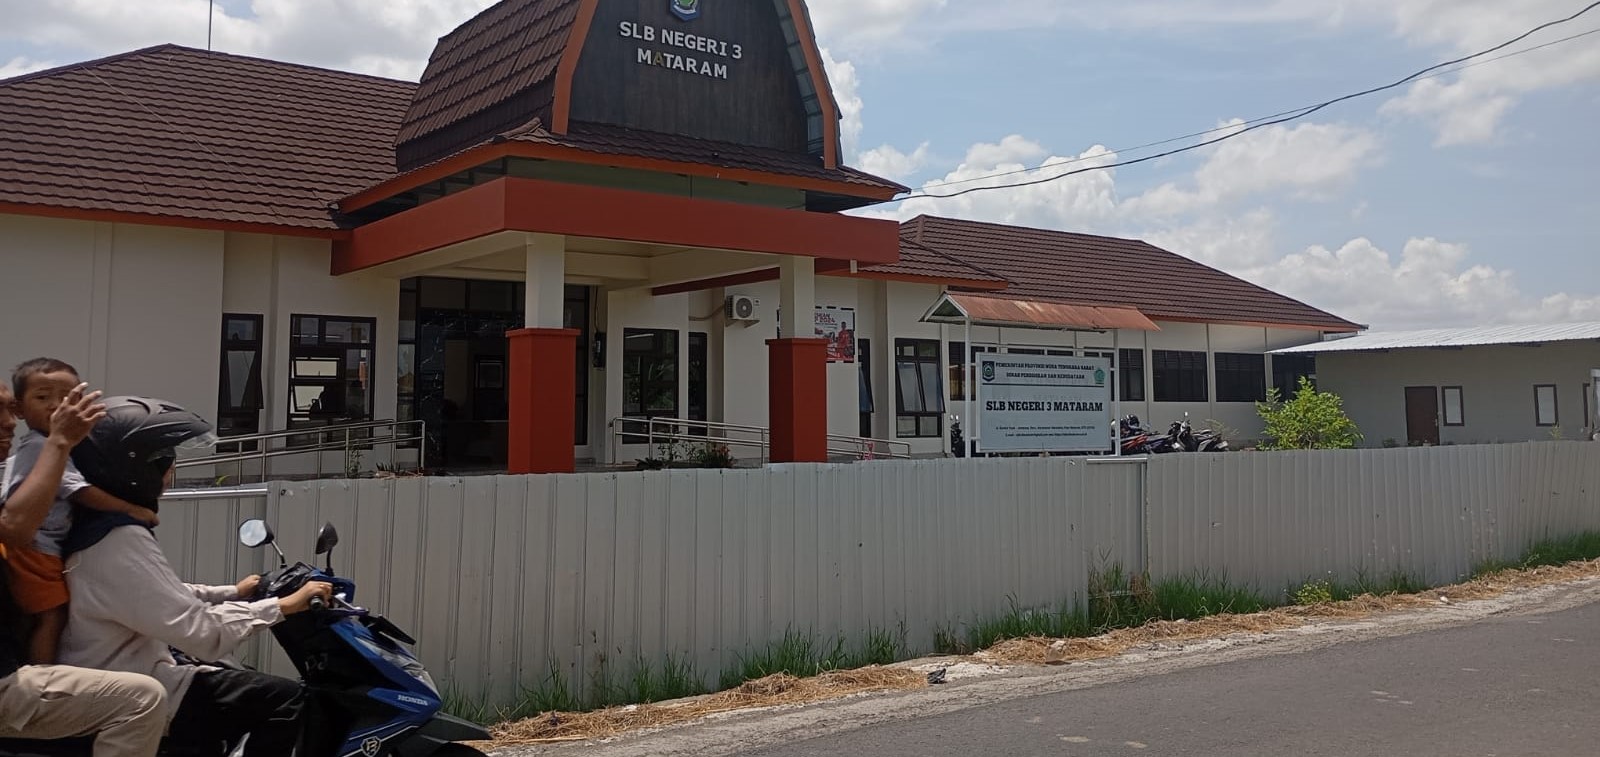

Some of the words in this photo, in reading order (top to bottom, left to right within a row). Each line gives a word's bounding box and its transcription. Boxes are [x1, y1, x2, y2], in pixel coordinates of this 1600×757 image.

[620, 21, 655, 41] SLB
[661, 28, 727, 57] NEGERI
[732, 44, 742, 59] 3
[637, 48, 727, 79] MATARAM
[985, 401, 1006, 411] SLB
[1007, 401, 1045, 411] NEGERI
[1046, 402, 1052, 411] 3
[1054, 402, 1103, 412] MATARAM
[398, 695, 428, 706] HONDA
